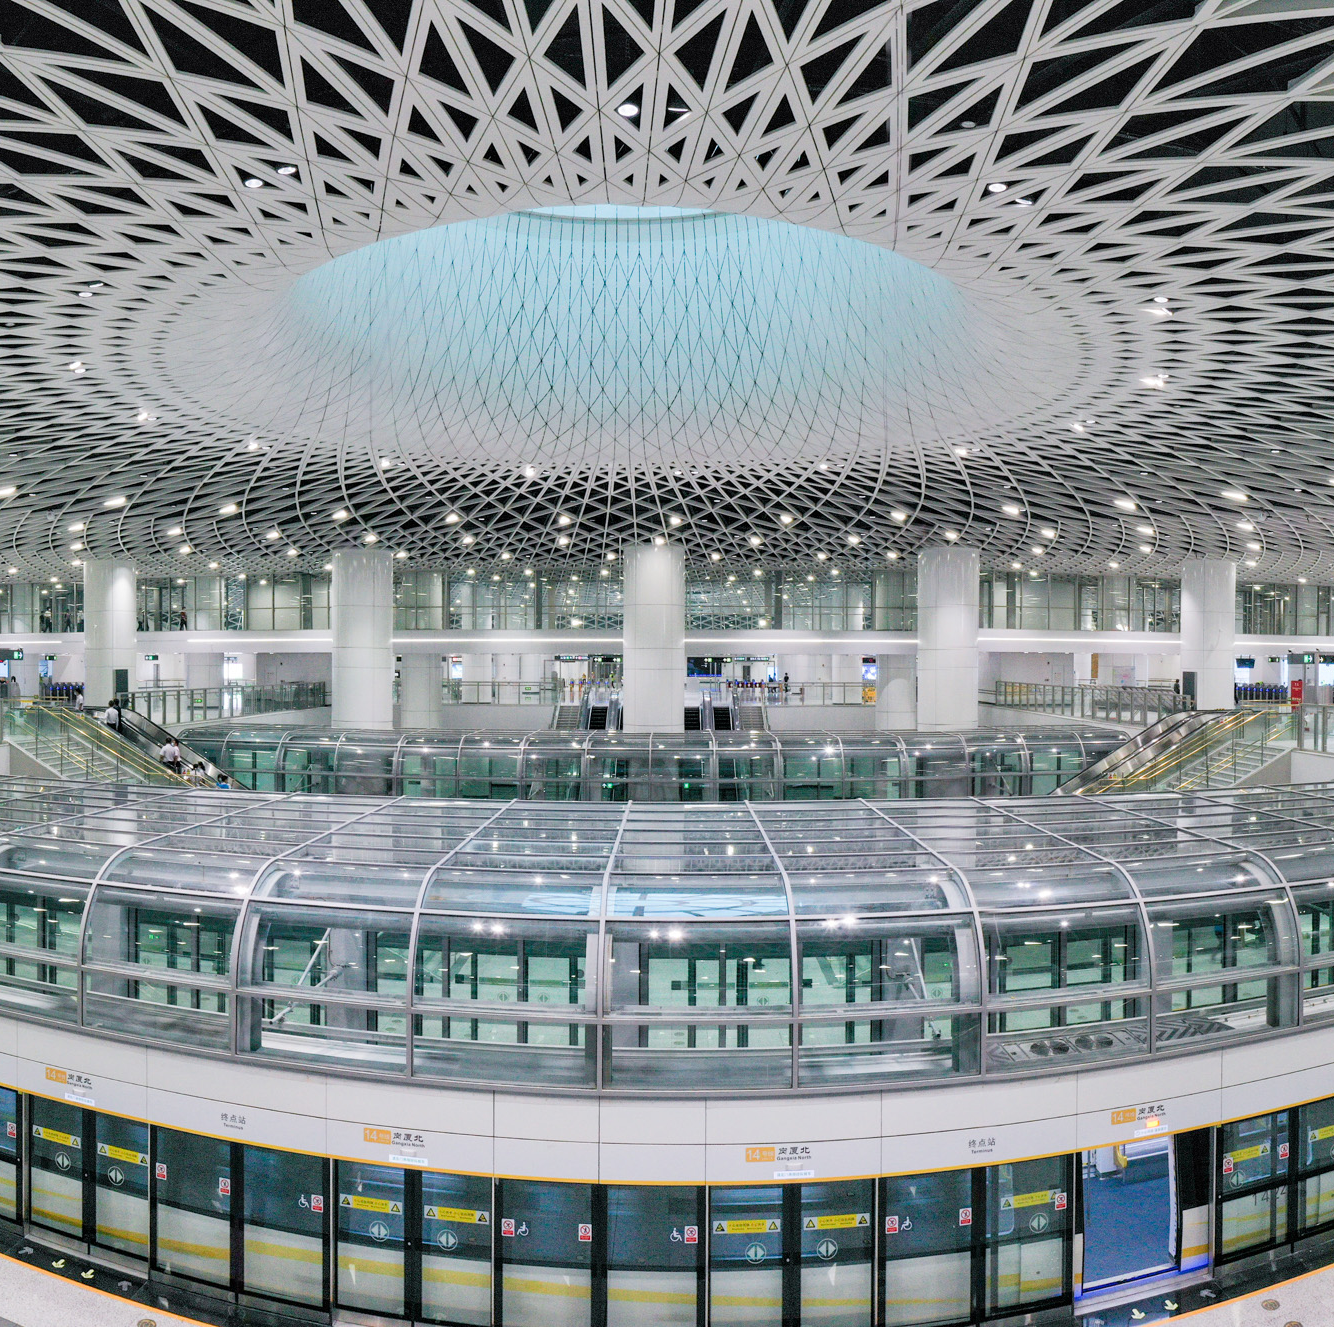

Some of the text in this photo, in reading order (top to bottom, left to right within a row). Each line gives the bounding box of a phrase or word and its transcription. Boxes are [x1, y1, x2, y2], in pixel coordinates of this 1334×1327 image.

[221, 1112, 246, 1125] 终点站
[968, 1137, 996, 1148] 终点站
[778, 1146, 810, 1155] 岗厦北
